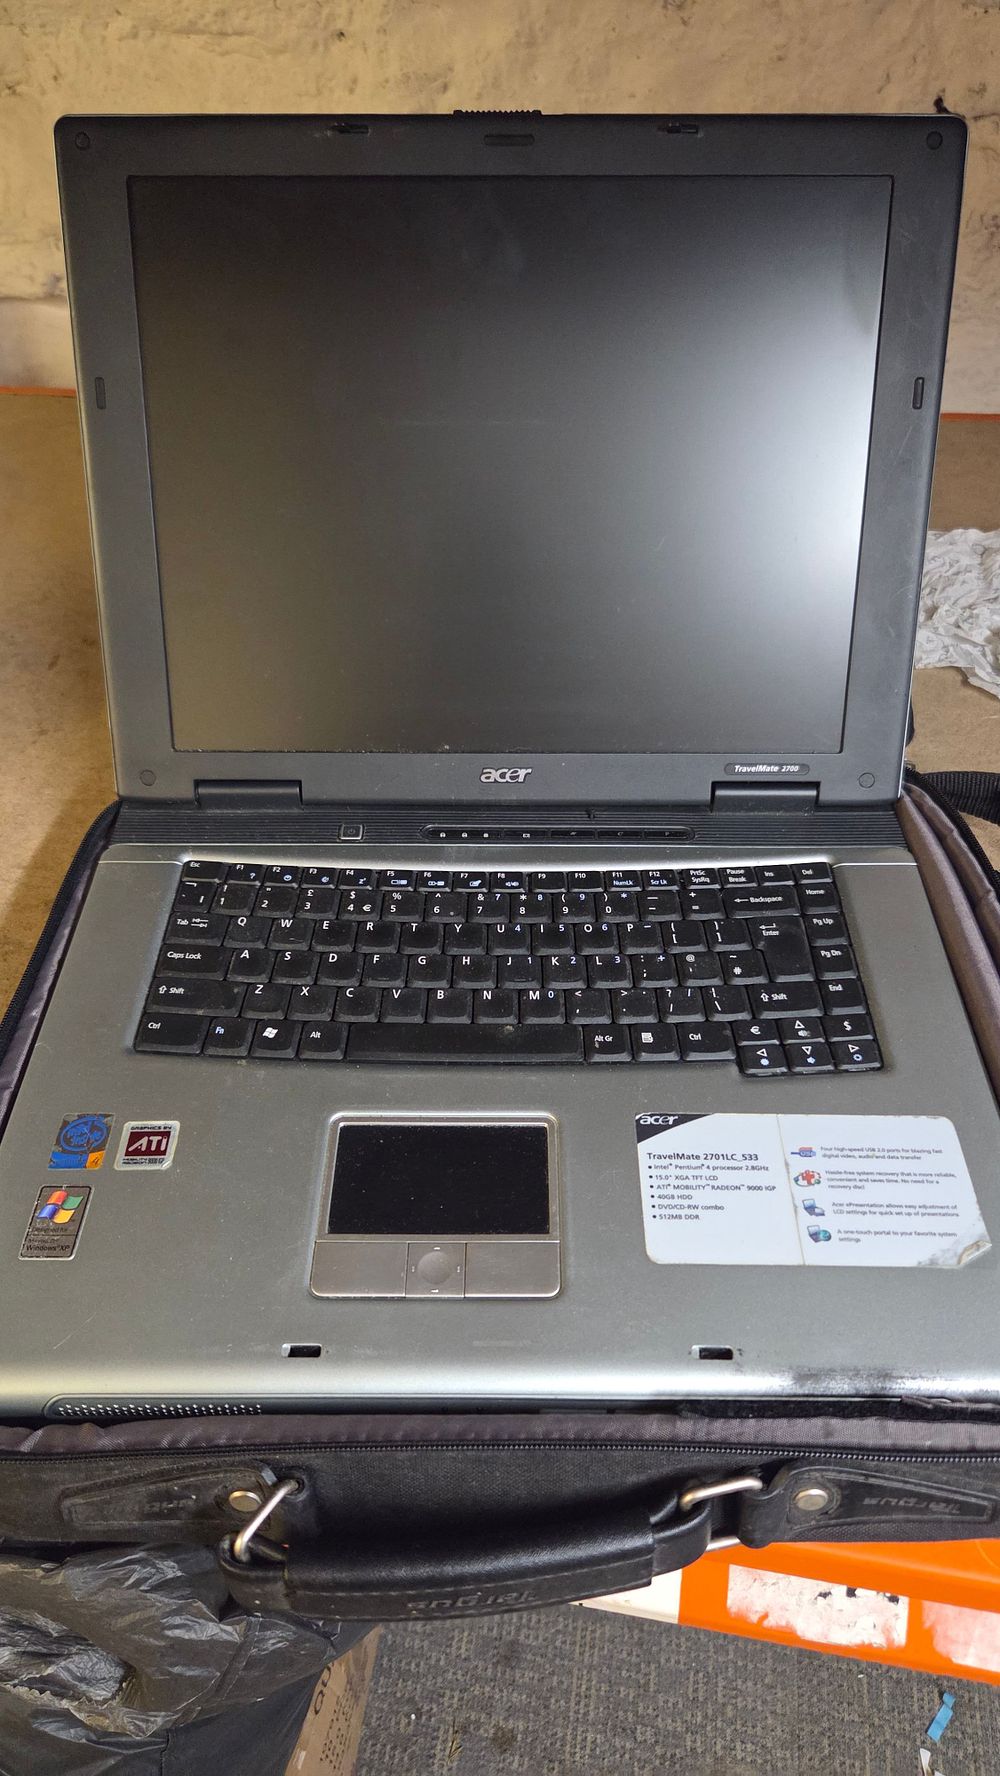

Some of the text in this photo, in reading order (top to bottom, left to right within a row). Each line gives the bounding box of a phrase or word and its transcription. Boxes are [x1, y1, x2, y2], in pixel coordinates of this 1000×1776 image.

[480, 768, 532, 783] acer
[750, 895, 782, 903] Backspace
[262, 900, 268, 908] 2
[304, 902, 311, 910] 3
[238, 917, 246, 926] Q
[281, 919, 292, 927] W
[323, 921, 329, 929] E
[366, 922, 374, 931] R
[411, 923, 418, 932] T
[455, 924, 462, 933] Y
[497, 925, 505, 933] U
[627, 924, 633, 932] P
[167, 951, 202, 960] Caps Lock
[240, 950, 249, 959] A
[284, 952, 291, 961] S
[329, 954, 337, 962] D
[373, 955, 380, 964] F
[418, 956, 427, 965] G
[462, 956, 470, 965] H
[507, 957, 512, 966] J
[552, 957, 559, 966] K
[596, 956, 602, 965] L
[255, 985, 263, 994] Z
[300, 986, 310, 996] X
[346, 988, 354, 997] C
[392, 989, 401, 999] V
[437, 990, 445, 999] B
[483, 991, 492, 1000] N
[529, 991, 540, 1000] M
[640, 1116, 678, 1125] acer
[647, 1152, 758, 1161] TravelMate 2701LC_533
